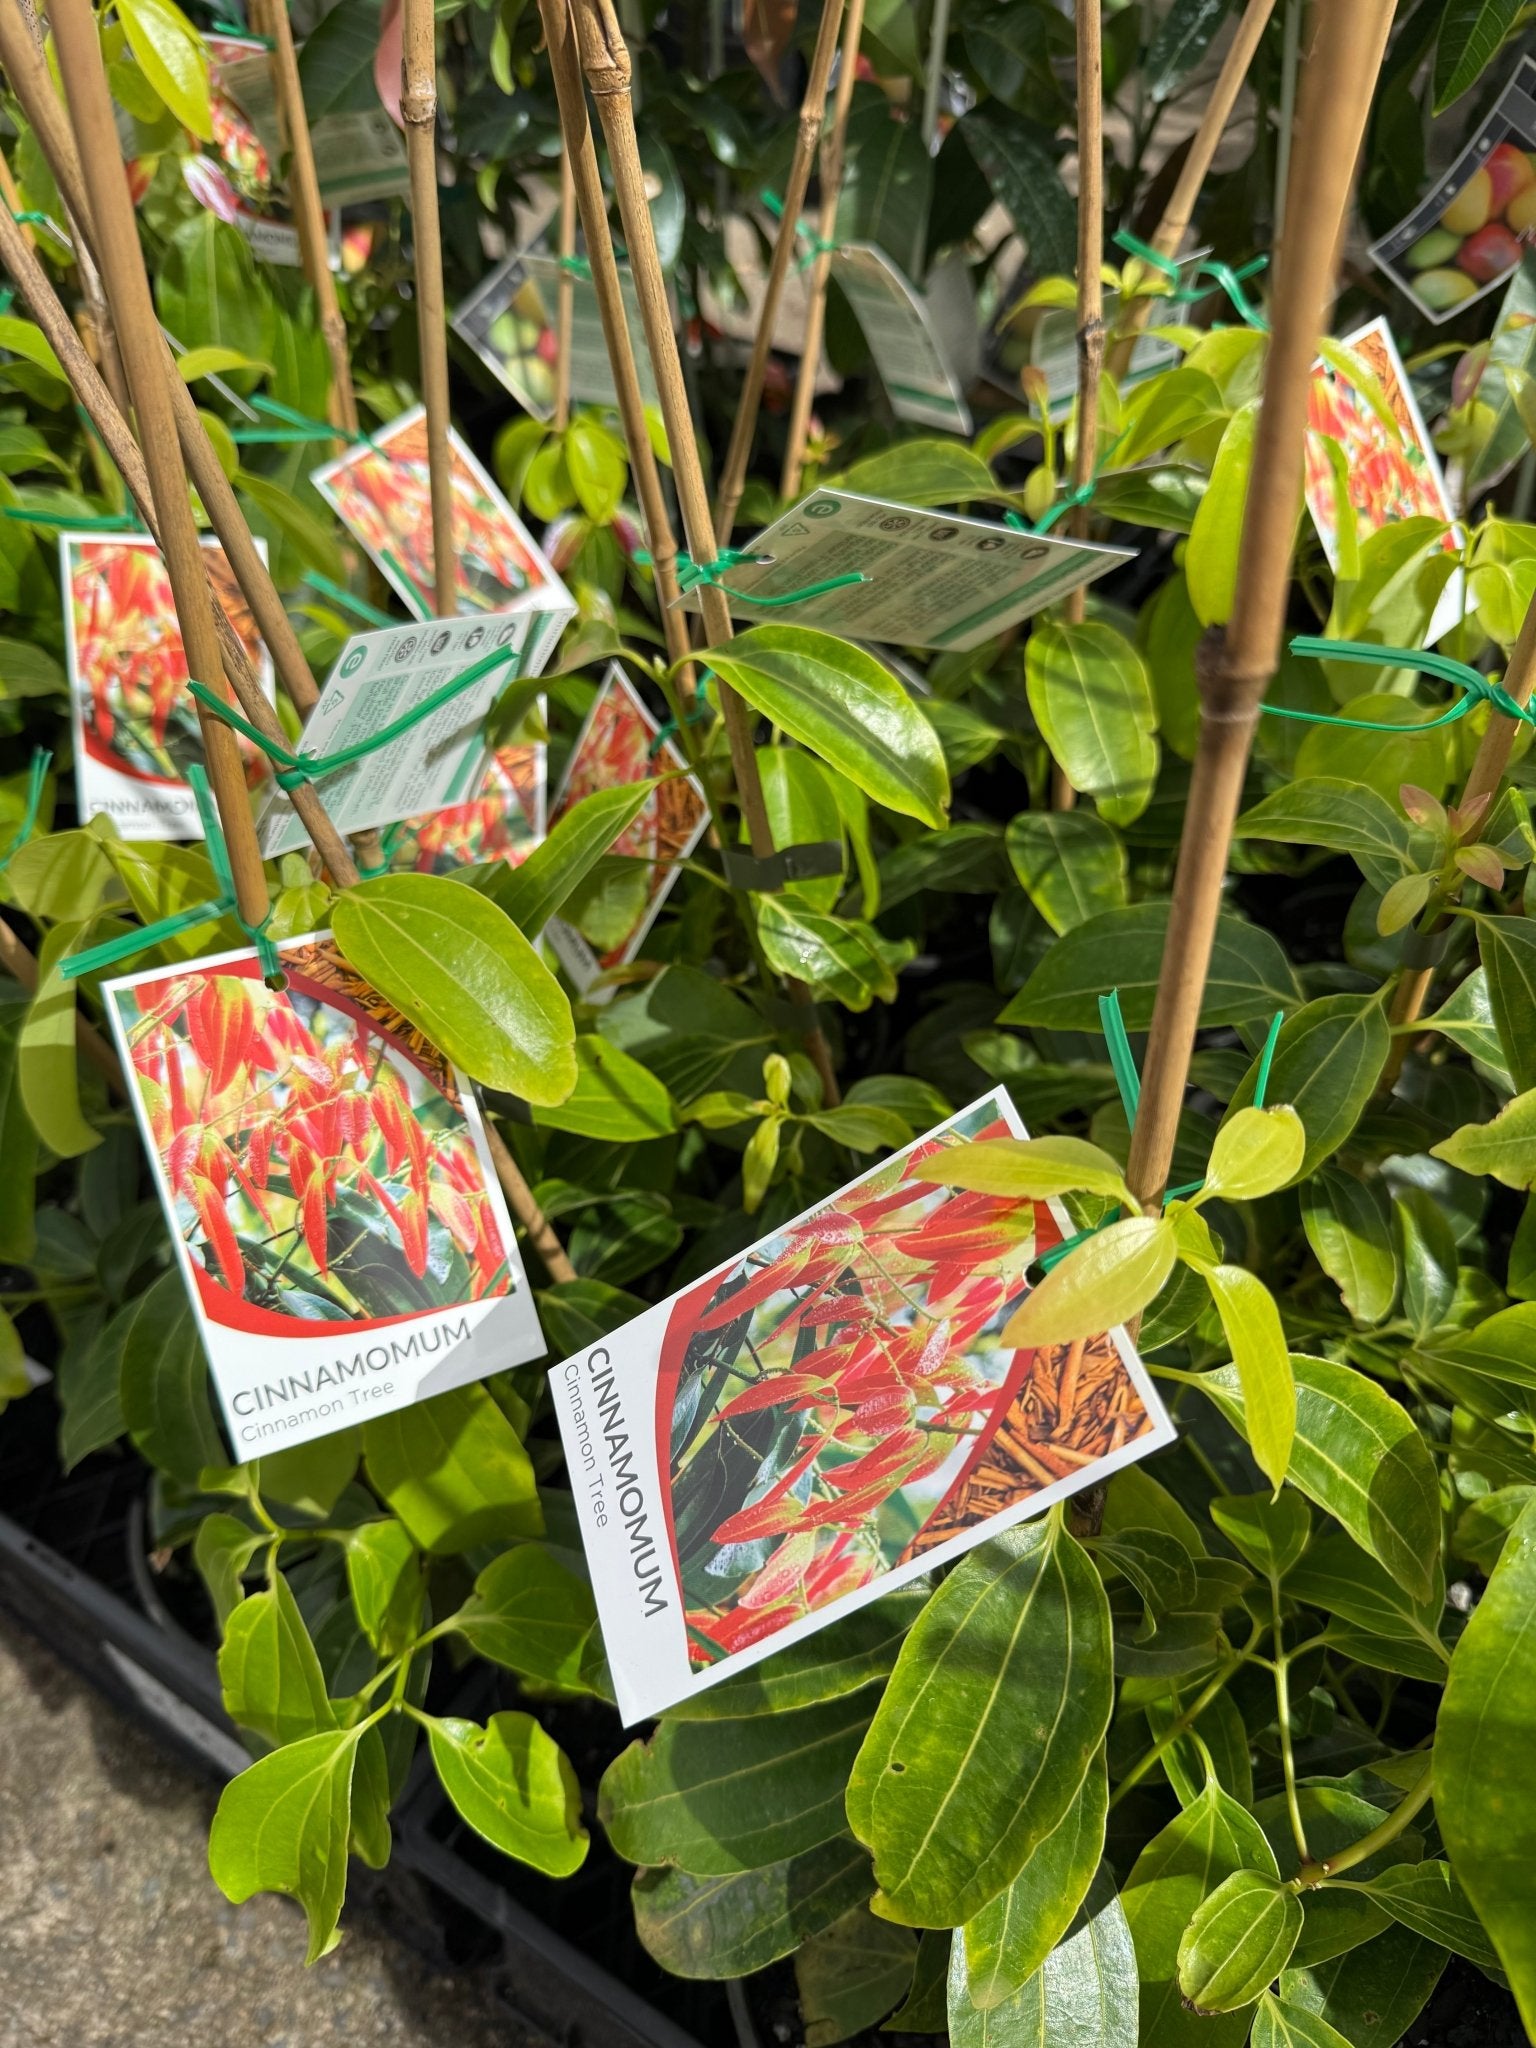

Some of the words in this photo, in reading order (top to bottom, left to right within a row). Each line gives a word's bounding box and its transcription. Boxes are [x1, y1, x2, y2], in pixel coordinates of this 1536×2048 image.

[90, 800, 198, 816] CINNAMO
[232, 1317, 473, 1416] CINNAMOMUM
[240, 1400, 344, 1443] Cinnamon
[348, 1380, 395, 1406] Tree
[564, 1364, 597, 1471] Cinnamon
[588, 1473, 608, 1528] Tree
[587, 1347, 669, 1618] CINNAMOMUM
